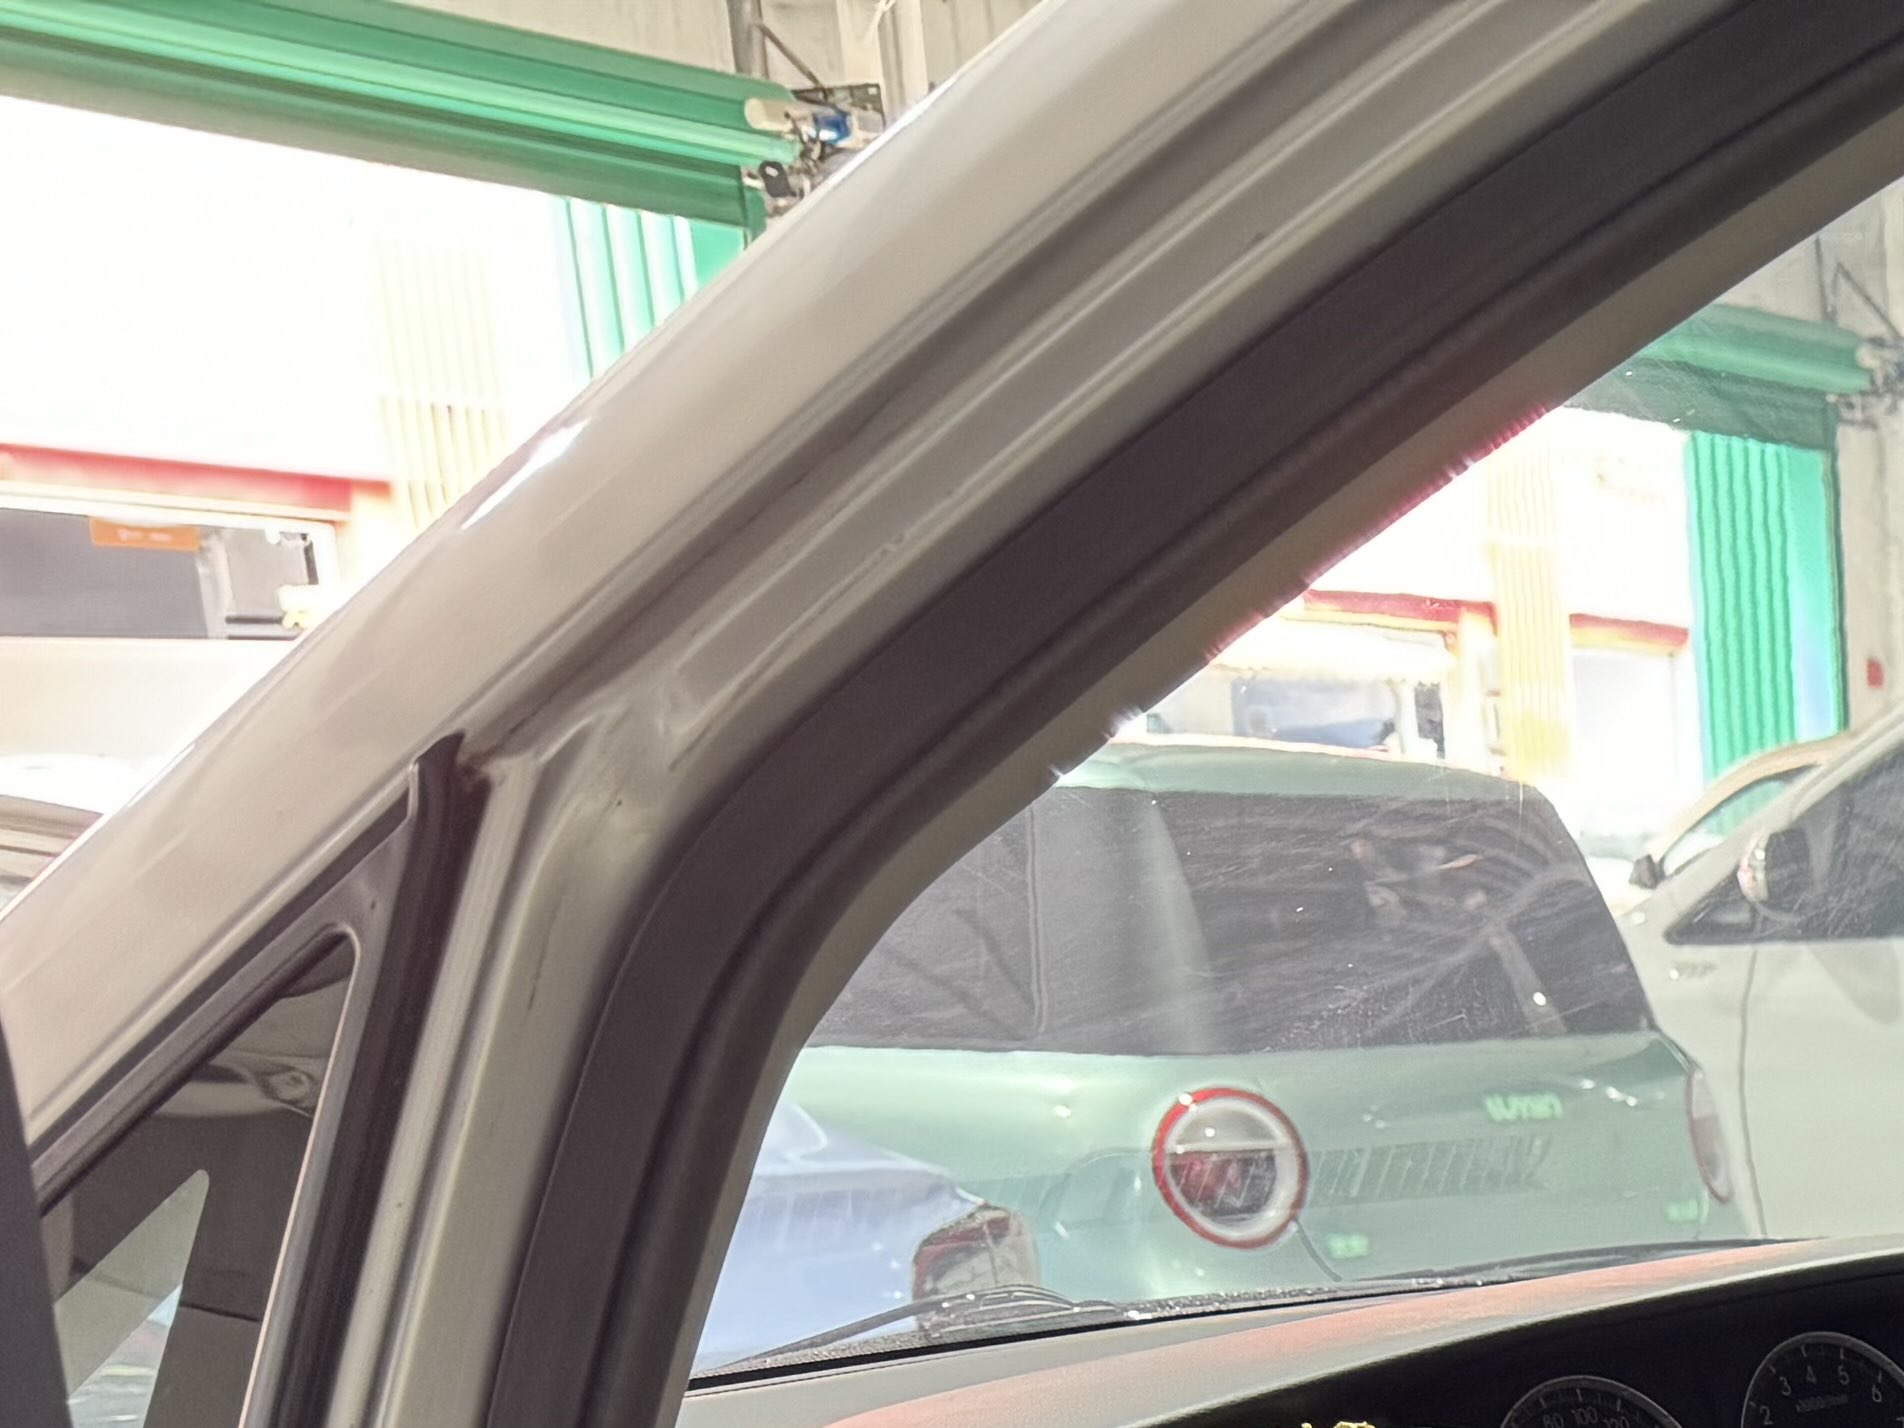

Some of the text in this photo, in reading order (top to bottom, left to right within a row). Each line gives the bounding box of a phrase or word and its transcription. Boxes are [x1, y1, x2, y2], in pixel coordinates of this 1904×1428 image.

[1760, 1405, 1773, 1425] 2
[1779, 1376, 1792, 1396] 3
[1805, 1364, 1817, 1384] 4
[1837, 1365, 1850, 1385] 5
[1871, 1384, 1882, 1403] 6
[1571, 1406, 1598, 1425] 100
